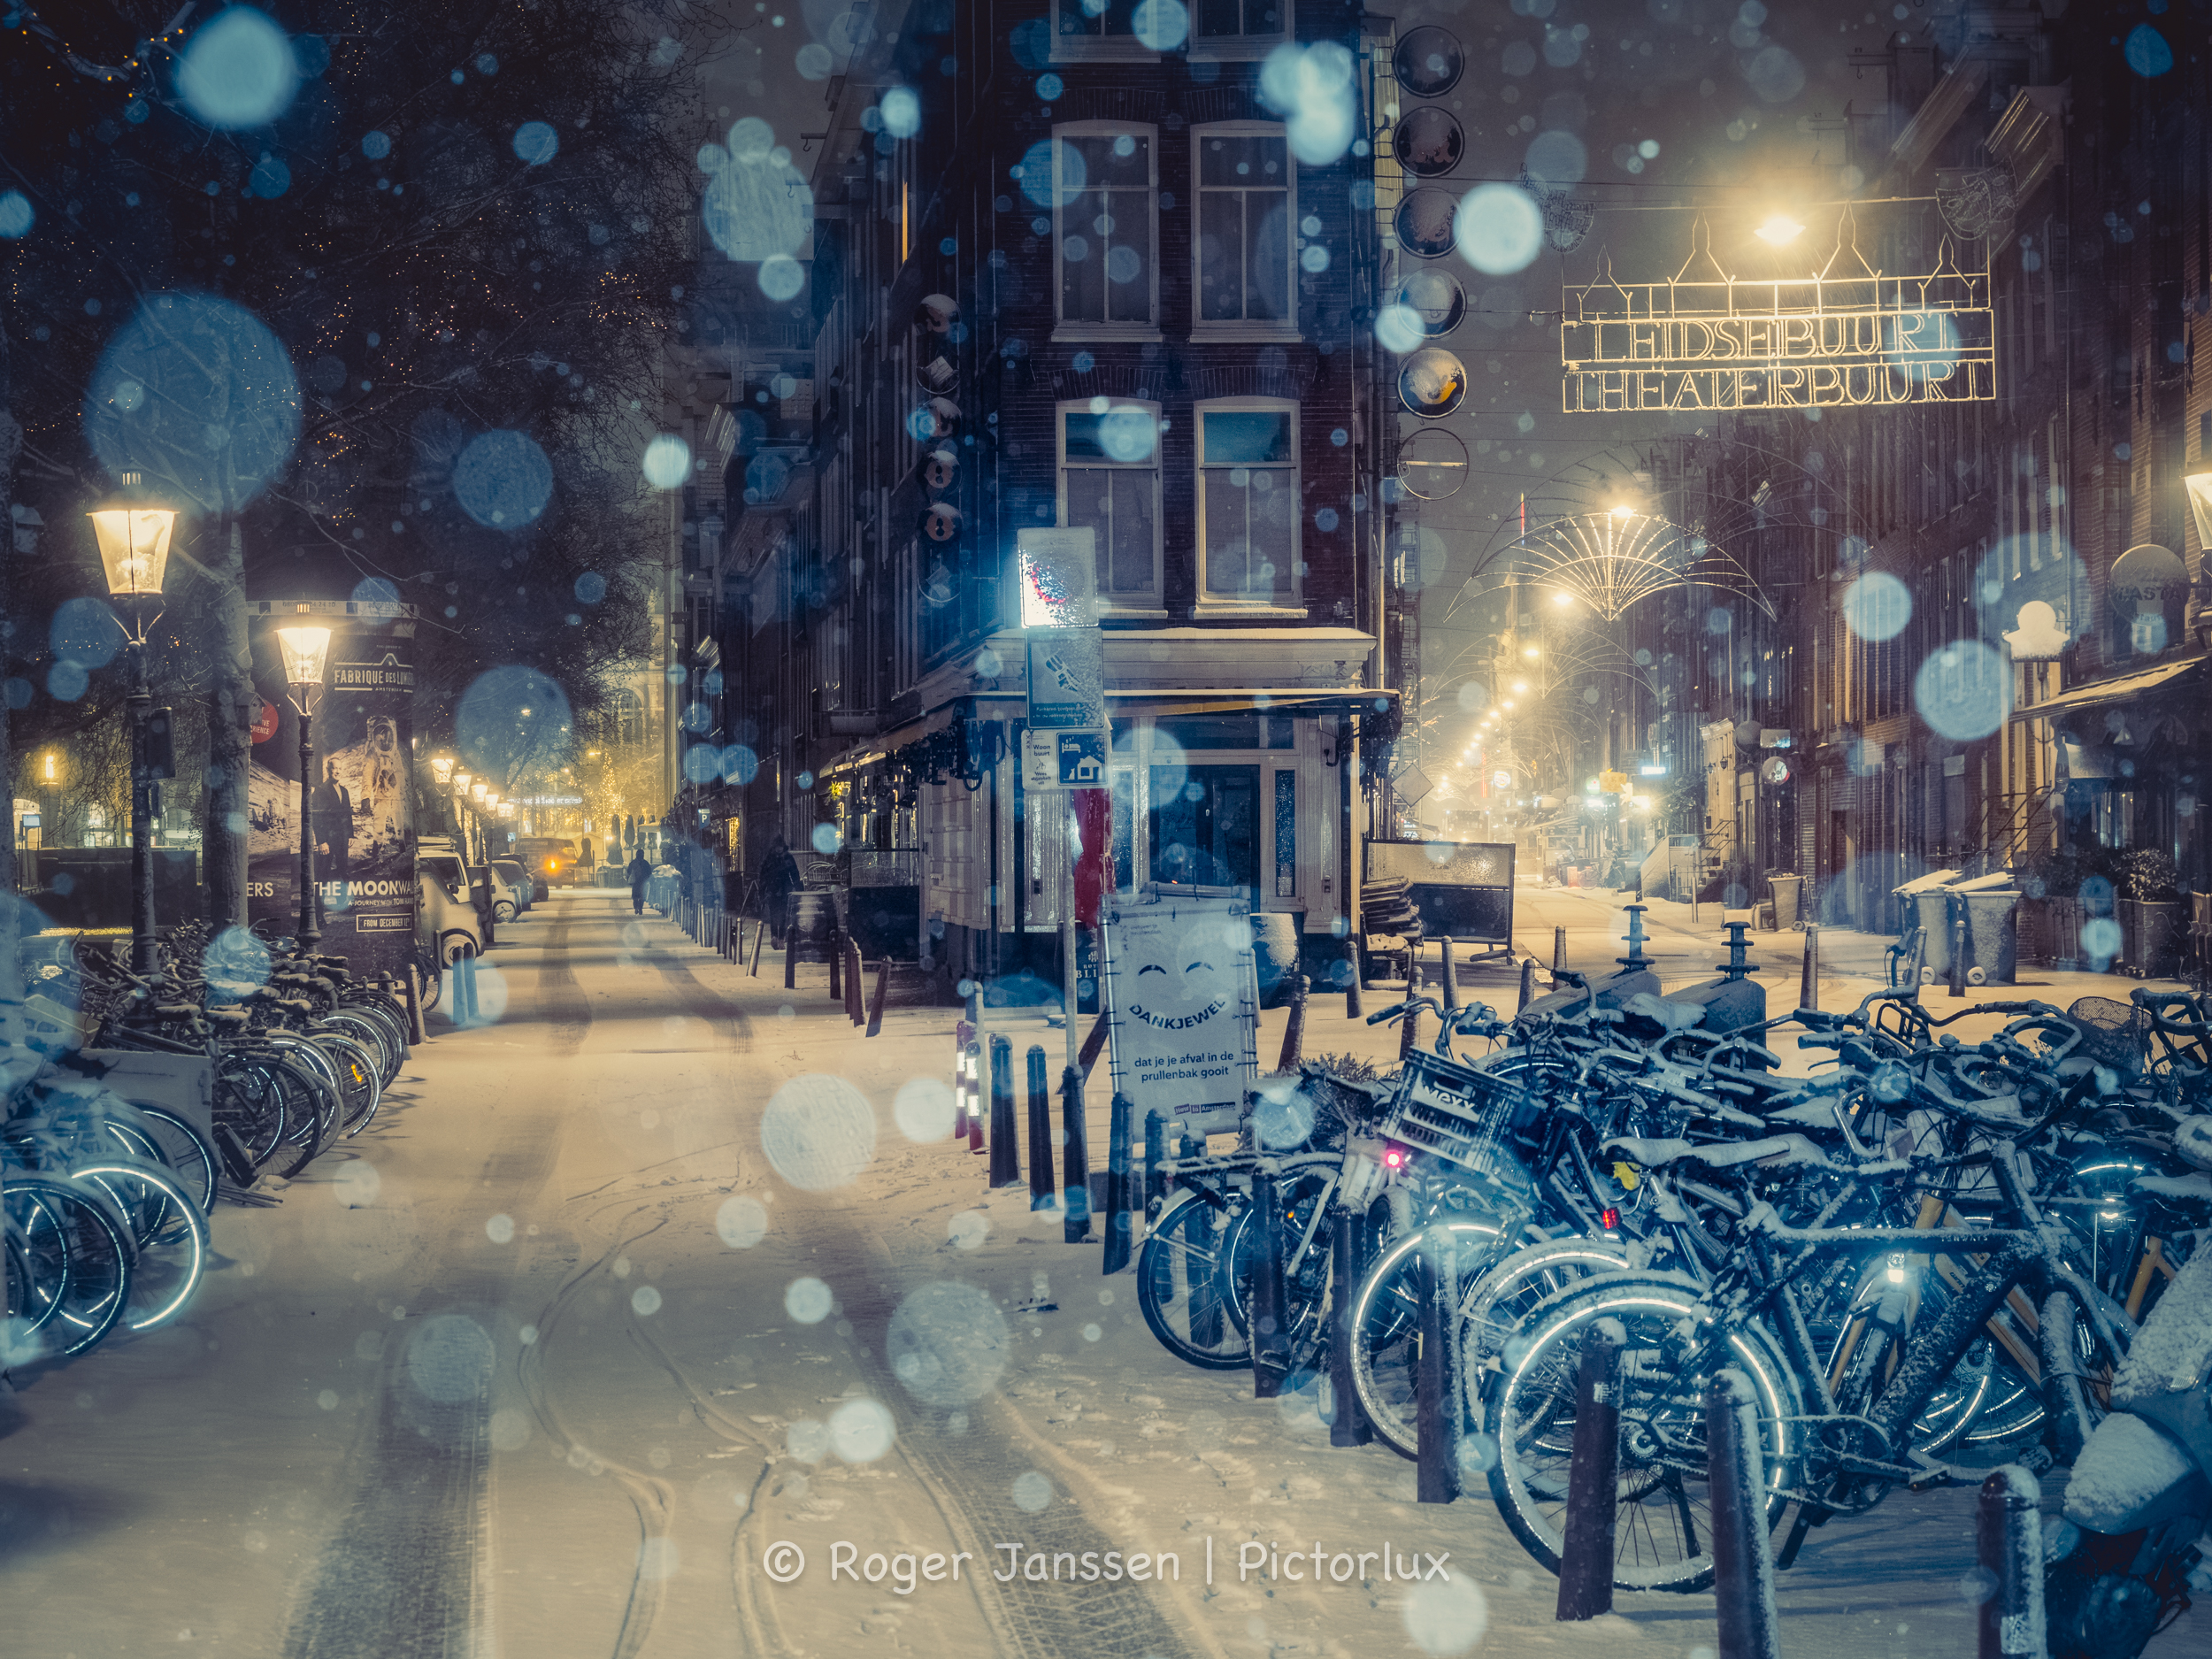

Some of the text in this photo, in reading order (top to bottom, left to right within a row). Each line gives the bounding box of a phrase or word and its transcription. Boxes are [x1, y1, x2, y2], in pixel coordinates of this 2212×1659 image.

[334, 669, 384, 685] FABRIQUE
[386, 672, 396, 683] DES
[380, 918, 403, 927] DECEMBER
[1129, 1000, 1226, 1030] DANKJEWEL
[1134, 1050, 1234, 1068] dat je je afval in de
[1141, 1065, 1229, 1083] prullenbak gooit
